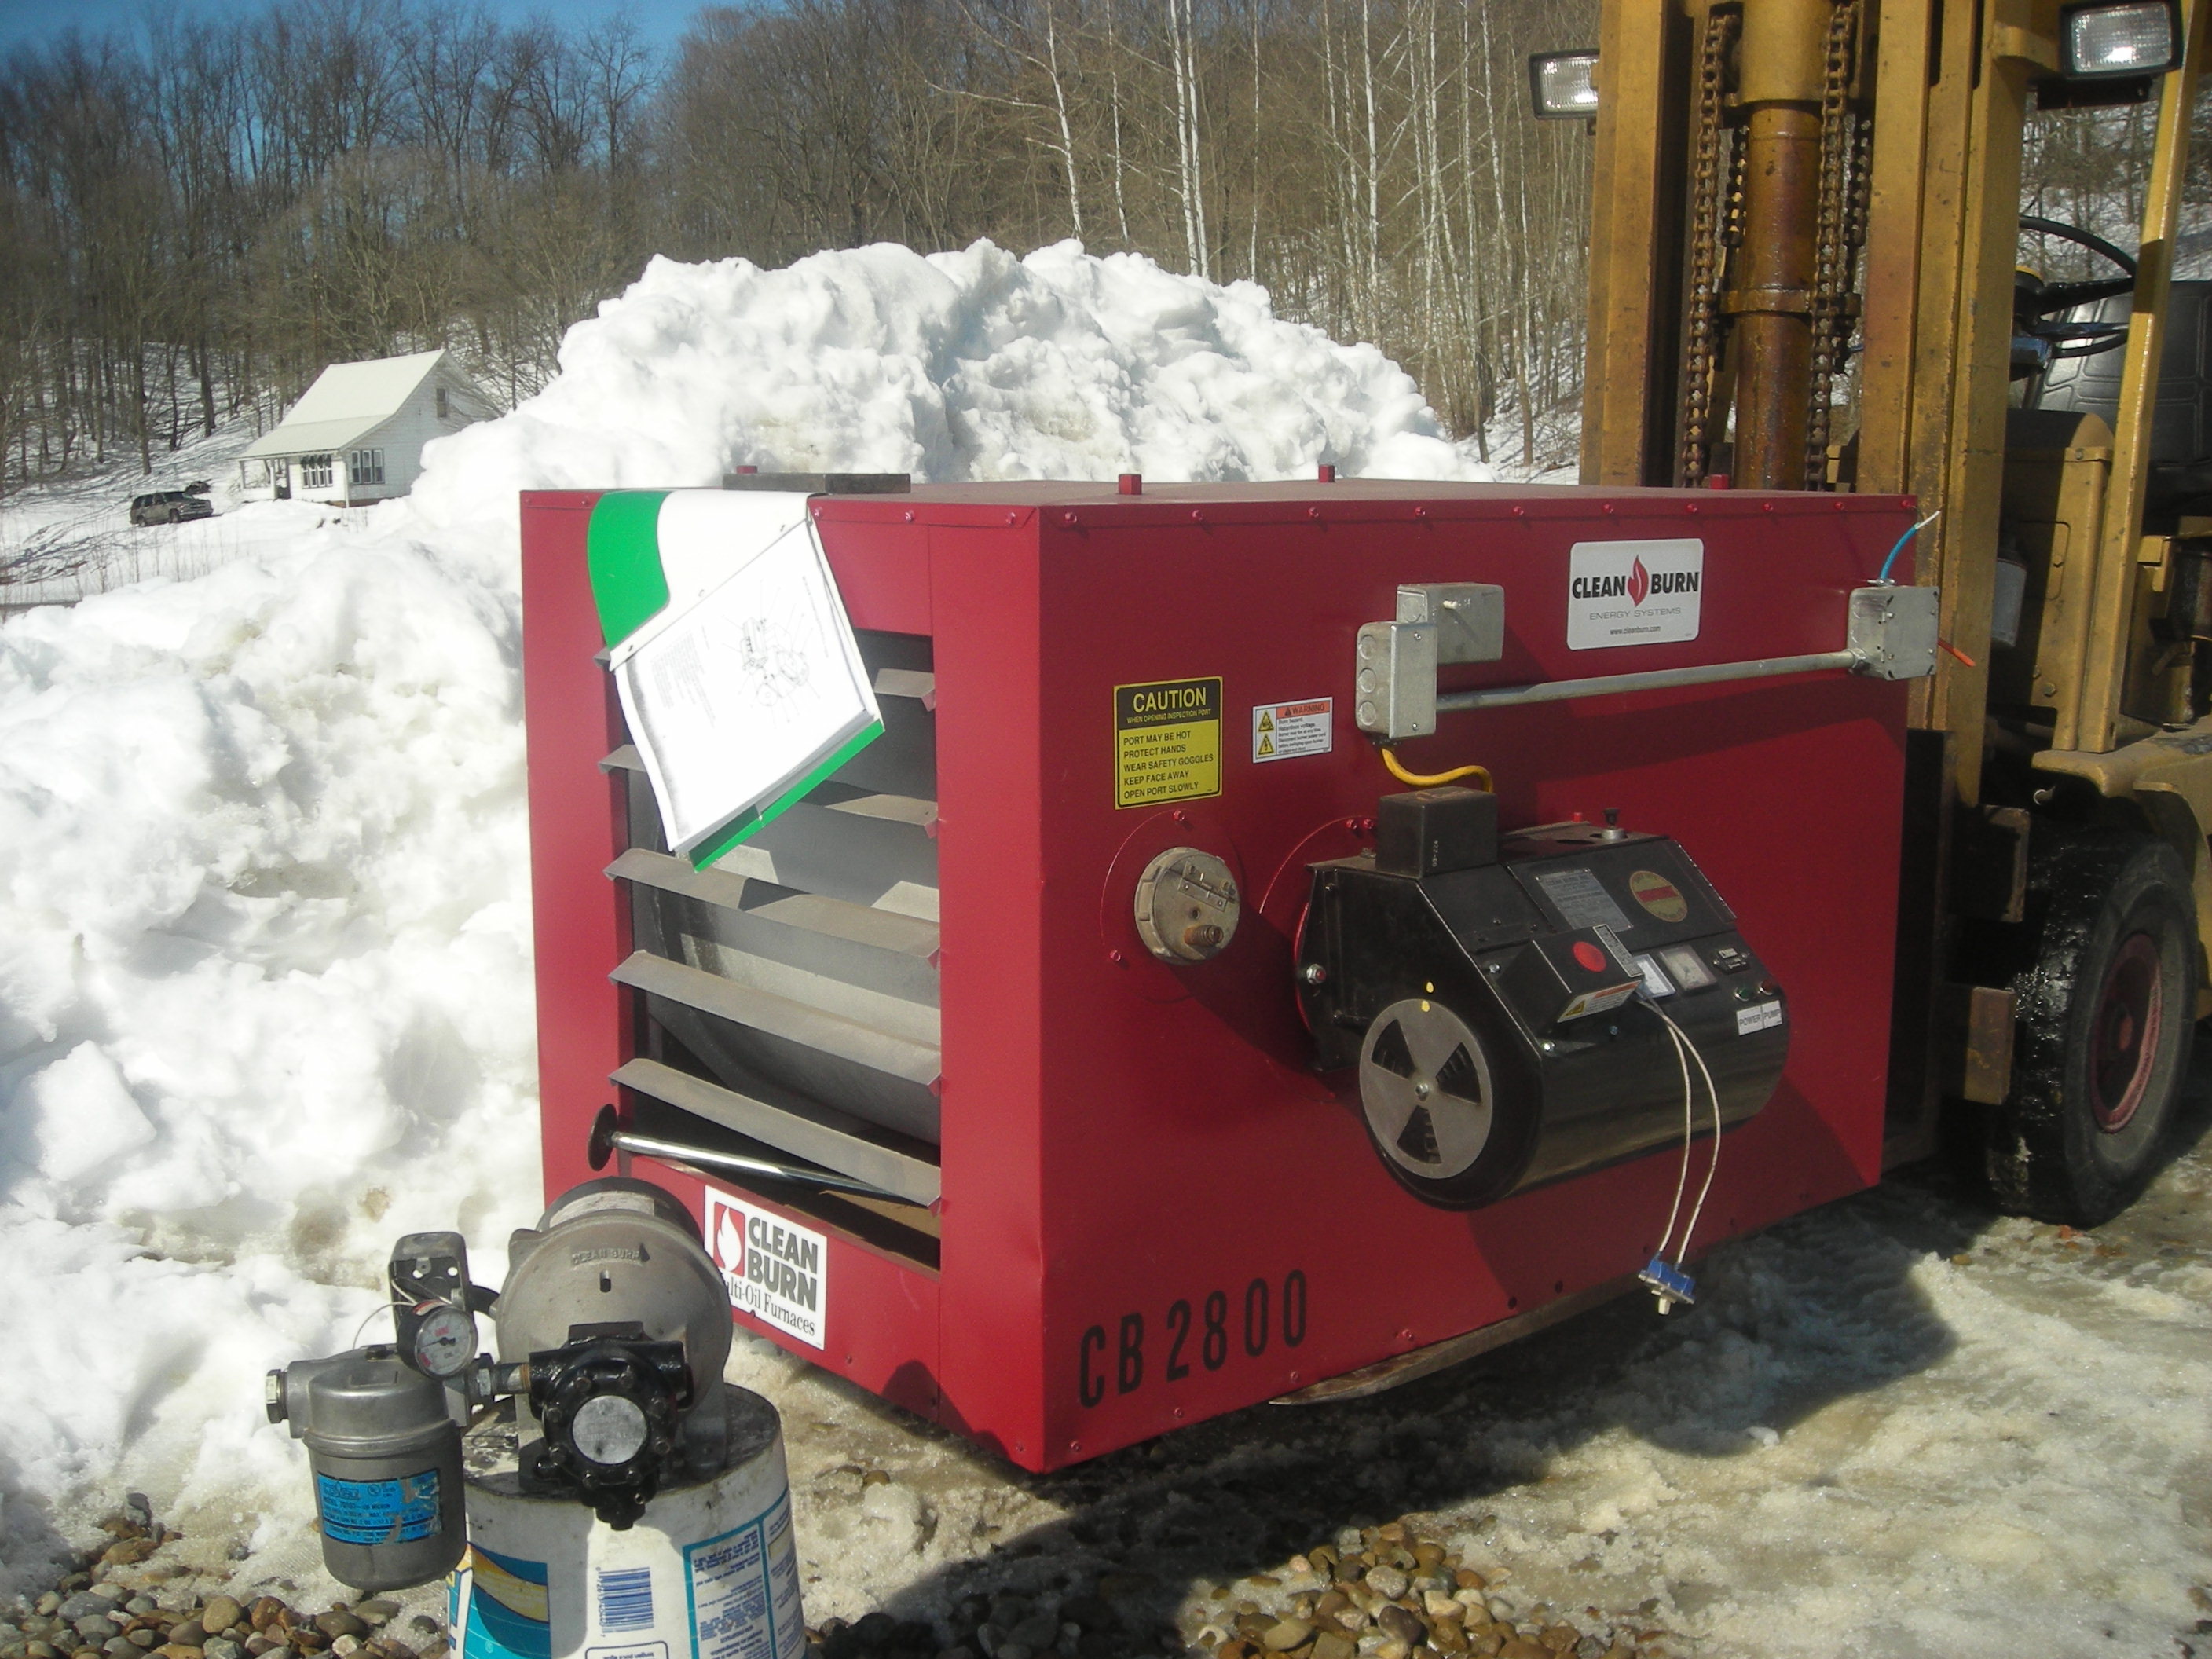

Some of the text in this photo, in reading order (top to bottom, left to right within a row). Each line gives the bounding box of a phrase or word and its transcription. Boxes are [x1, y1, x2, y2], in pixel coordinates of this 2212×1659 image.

[1572, 572, 1699, 599] CLEAN BURN
[1589, 607, 1682, 621] ENERGY SYSTEMS
[1133, 687, 1207, 712] CAUTION
[1143, 713, 1167, 723] OPENING
[1168, 710, 1198, 720] INSPECTION
[1291, 703, 1325, 715] WARNING
[1123, 730, 1192, 745] PORT MAY BE HOT
[1123, 744, 1186, 759] PROTECT HANDS
[1123, 753, 1214, 772] WEAR SAFETY GOGGLES
[1124, 770, 1189, 786] KEEP FACE AWAY
[1124, 782, 1199, 799] OPEN PORT SLOWLY
[1739, 1009, 1780, 1026] POWER PUMP
[748, 1217, 818, 1275] CLEAN
[571, 1248, 607, 1266] CLEAN
[748, 1247, 817, 1312] BURN
[726, 1276, 815, 1336] ulti-Oil Furnaces
[1079, 1269, 1306, 1408] CB 2800
